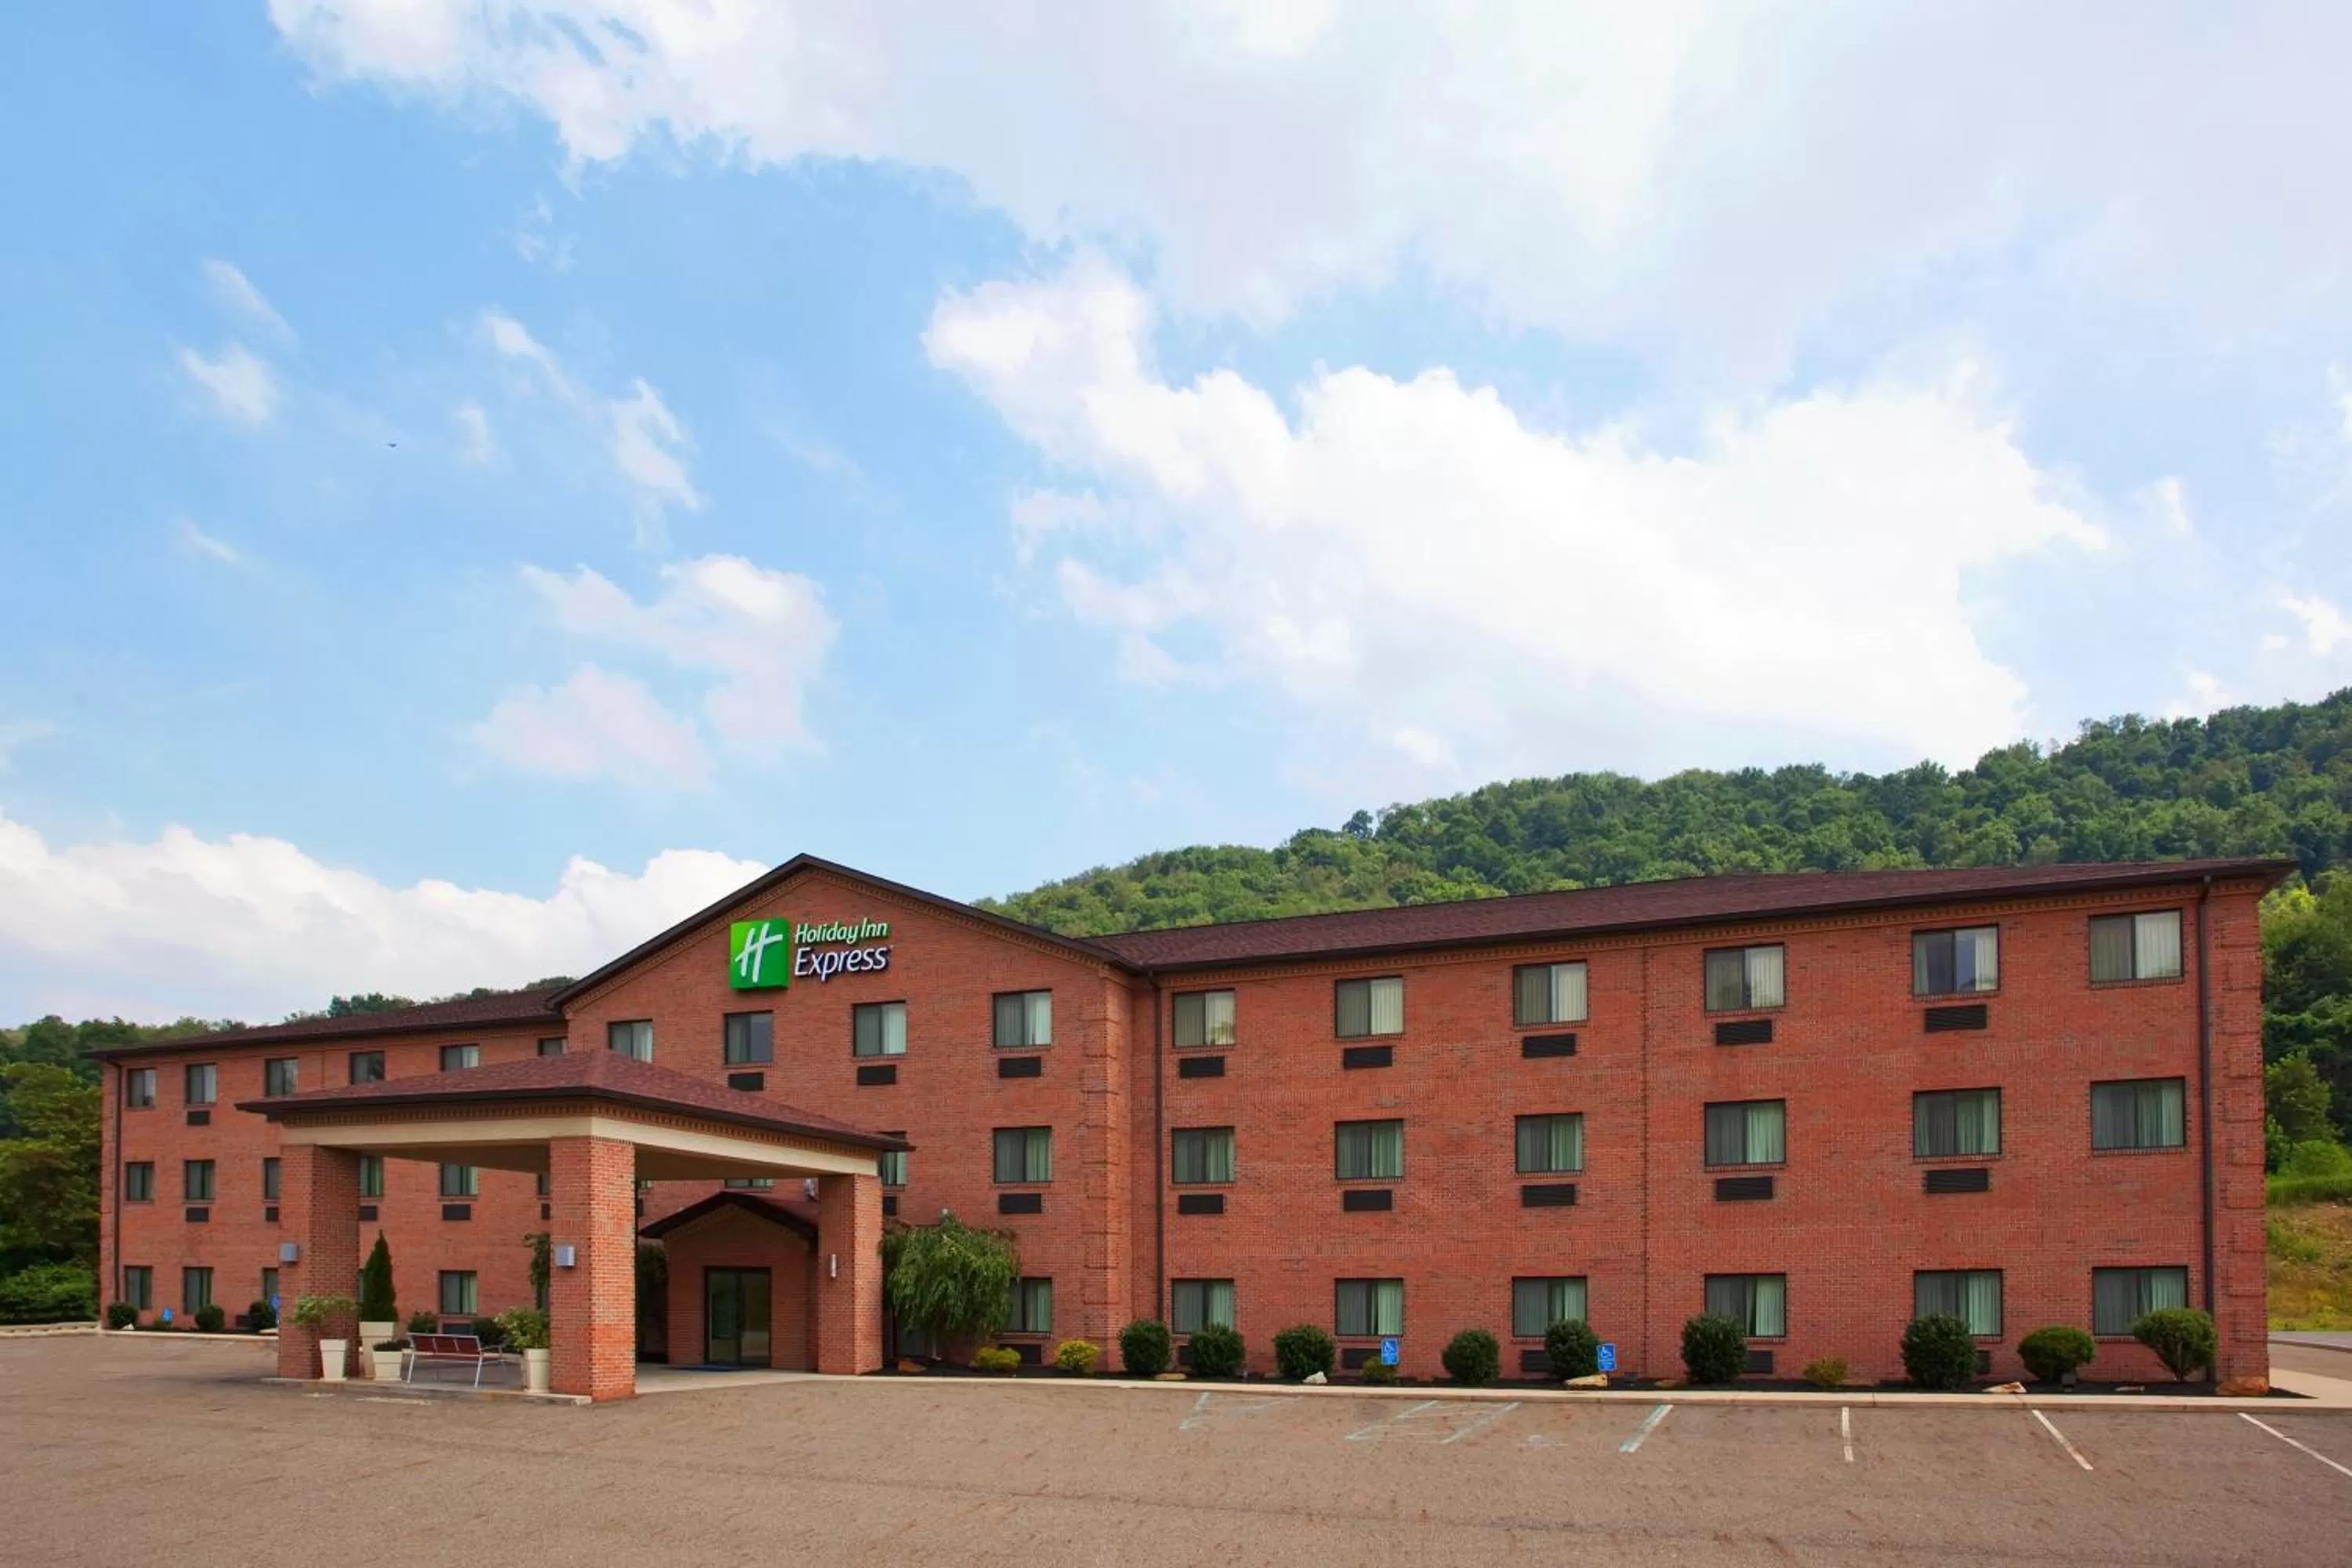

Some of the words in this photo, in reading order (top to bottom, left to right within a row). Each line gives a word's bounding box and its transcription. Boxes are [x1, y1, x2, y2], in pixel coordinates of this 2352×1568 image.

[794, 923, 858, 945] Holiday
[861, 917, 887, 938] Inn
[794, 946, 888, 982] Express
